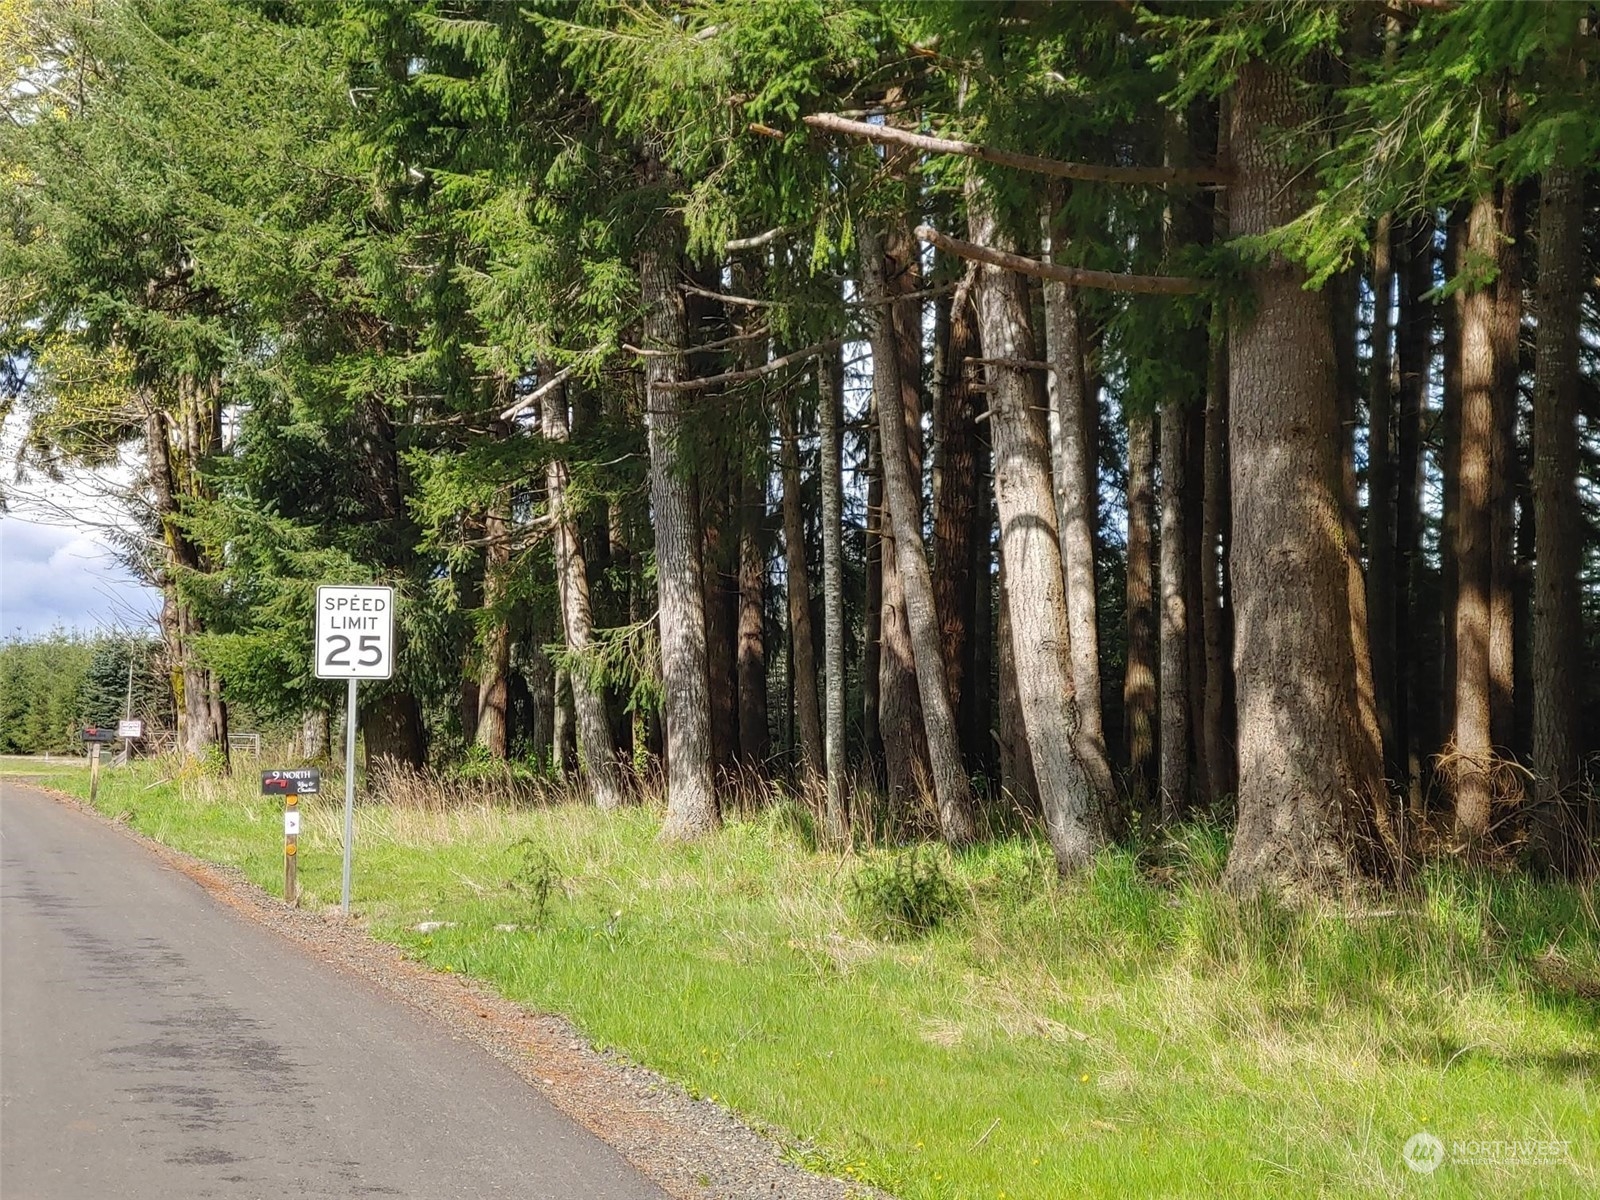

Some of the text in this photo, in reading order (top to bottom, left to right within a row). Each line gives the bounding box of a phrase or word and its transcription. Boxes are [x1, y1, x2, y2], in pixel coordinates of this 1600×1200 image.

[325, 597, 386, 612] SPEED
[331, 616, 378, 630] LIMIT
[325, 634, 383, 667] 25
[272, 771, 311, 781] 9 NORTH
